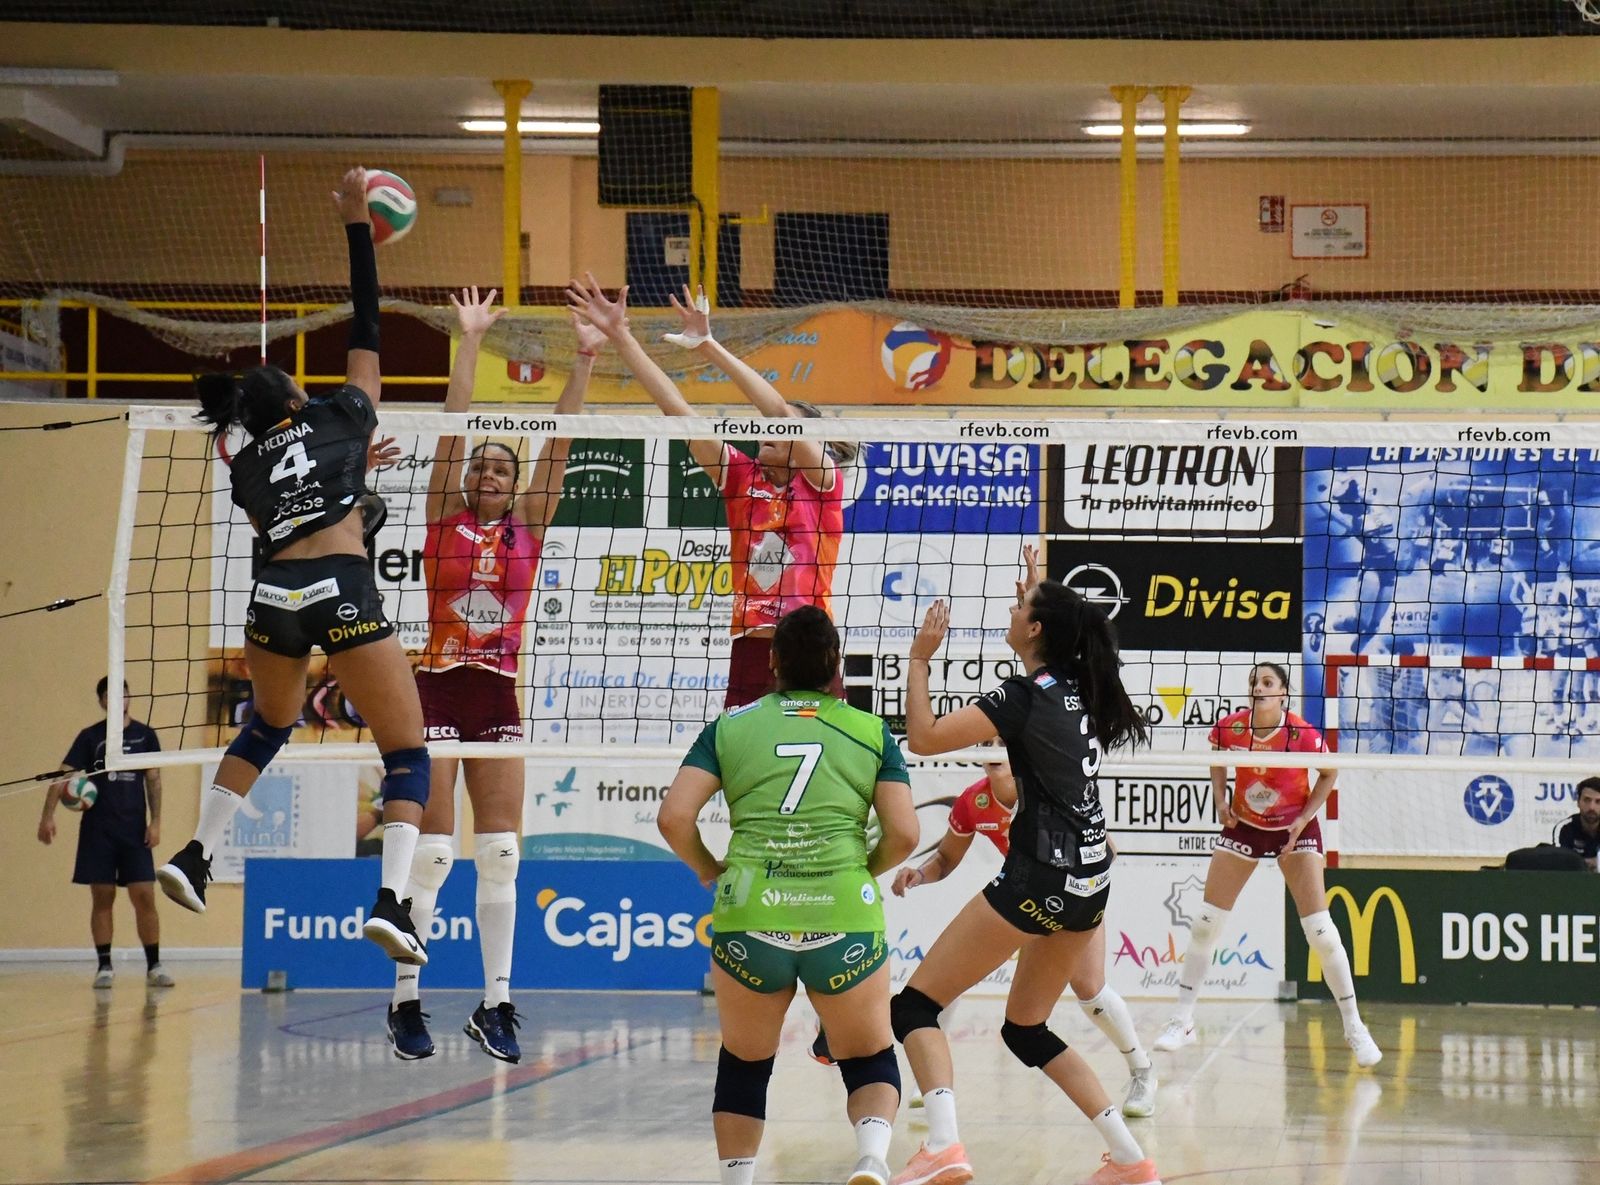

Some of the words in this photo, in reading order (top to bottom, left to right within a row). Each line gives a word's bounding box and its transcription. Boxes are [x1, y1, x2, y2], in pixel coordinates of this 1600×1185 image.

[467, 416, 557, 431] rfevb.com
[714, 420, 803, 435] rfevb.com
[959, 423, 1050, 438] rfevb.com
[1207, 425, 1298, 440] rfevb.com
[1458, 427, 1551, 442] rfevb.com
[257, 422, 314, 456] MEDINA
[269, 441, 317, 484] 4
[874, 444, 1030, 476] JUVASA
[1081, 444, 1260, 486] LEOTRON
[560, 487, 631, 499] SEVILLA
[875, 484, 1032, 507] PACKAGING
[1080, 494, 1100, 510] Tu
[1108, 494, 1258, 513] polivitamínico
[595, 555, 637, 596] El
[636, 548, 733, 610] Poyo
[1145, 574, 1291, 620] Divisa
[328, 620, 379, 643] Divisa
[548, 637, 565, 646] 954
[584, 637, 594, 646] 13
[651, 637, 662, 646] 50
[679, 637, 690, 646] 75
[713, 637, 730, 646] 680
[882, 654, 1015, 680] Brda
[776, 743, 823, 815] 7
[1179, 836, 1206, 850] ENTRE
[782, 892, 836, 902] Valiente
[264, 907, 473, 940] Fundón
[1442, 912, 1529, 962] DOS
[714, 945, 763, 987] Divisa
